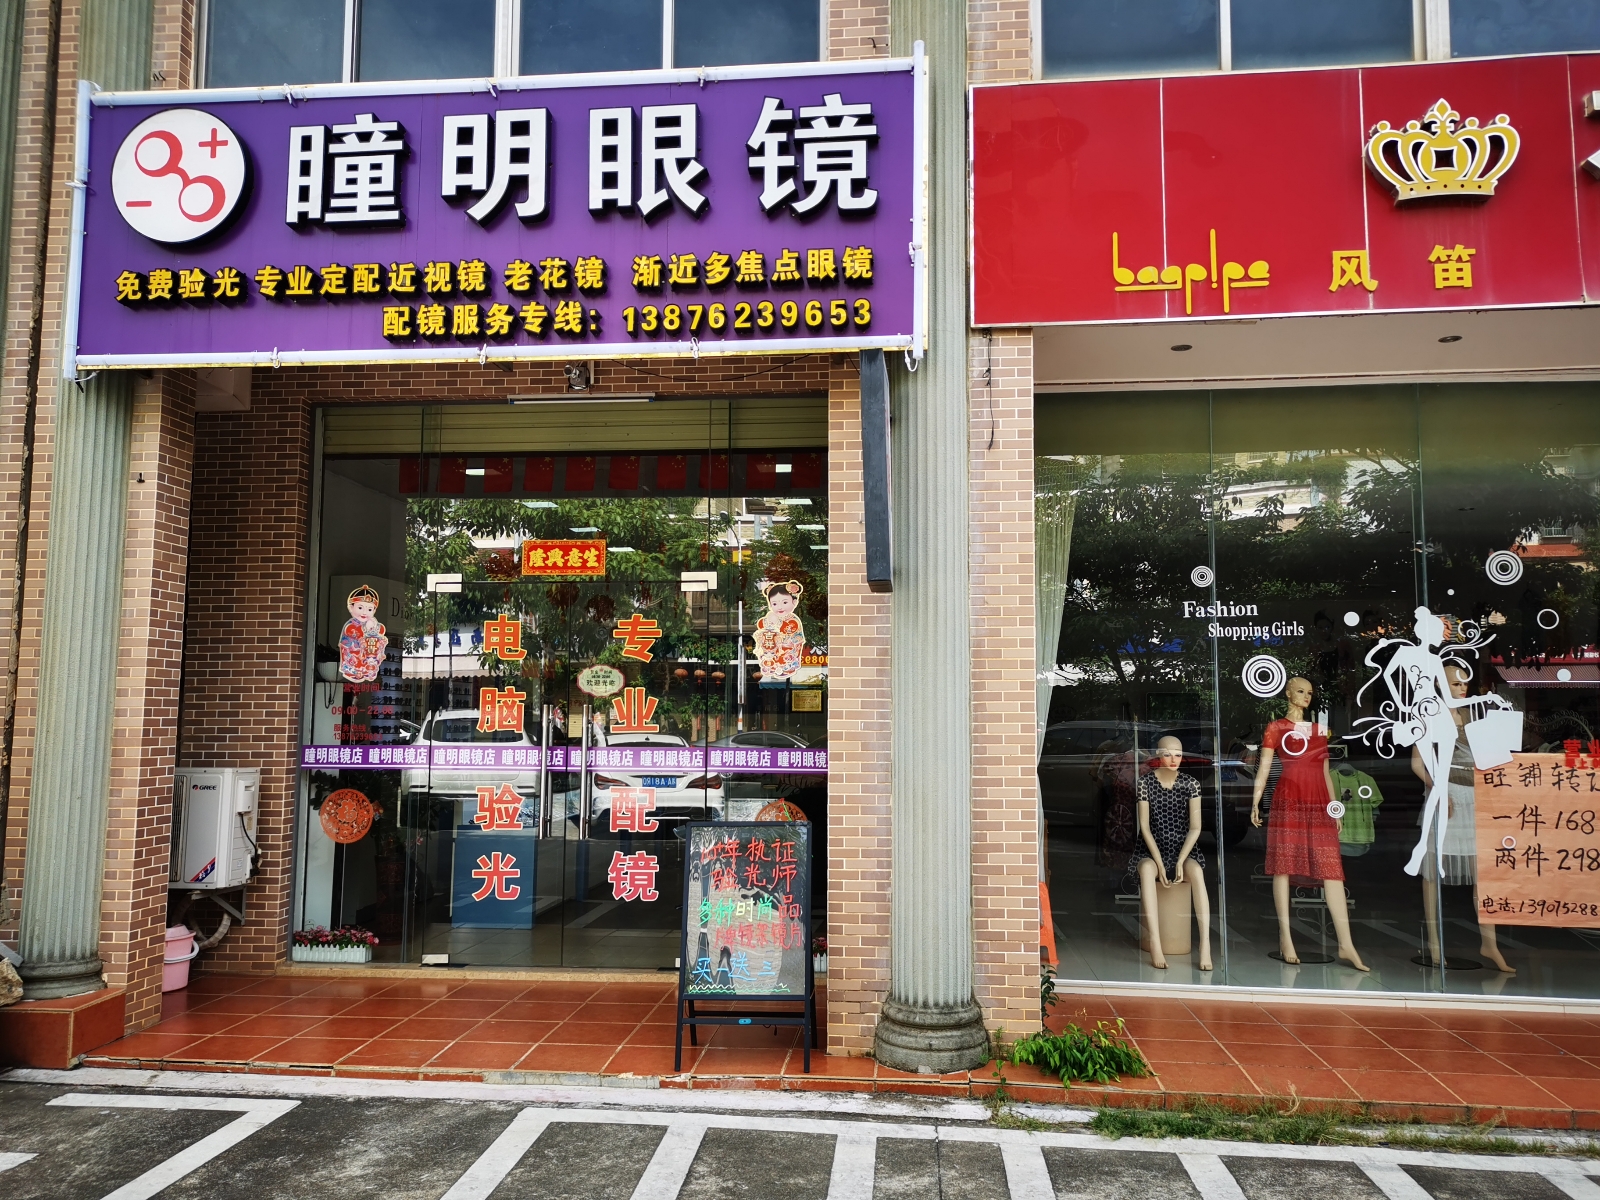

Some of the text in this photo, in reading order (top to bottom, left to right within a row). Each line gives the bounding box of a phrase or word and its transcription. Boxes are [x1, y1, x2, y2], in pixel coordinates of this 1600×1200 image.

[286, 93, 878, 222] 瞳明眼镜
[115, 246, 874, 301] 免费验光 专业定配近视镜 老花镜 渐近多焦点眼镜
[1329, 244, 1477, 292] 风笛
[622, 298, 872, 332] 13876239653
[1182, 601, 1259, 618] Fashion
[1208, 621, 1305, 640] Shopping Girls
[305, 747, 363, 764] 瞳明眼镜店
[368, 747, 428, 764] 瞳明眼镜店
[433, 748, 496, 765] 瞳明眼镜店
[640, 750, 704, 767] 瞳明眼镜店
[711, 750, 772, 767] 瞳明眼镜店
[777, 751, 828, 768] 瞳明眼镜
[1492, 804, 1596, 836] 一件 168
[1494, 843, 1600, 877] 两件 298
